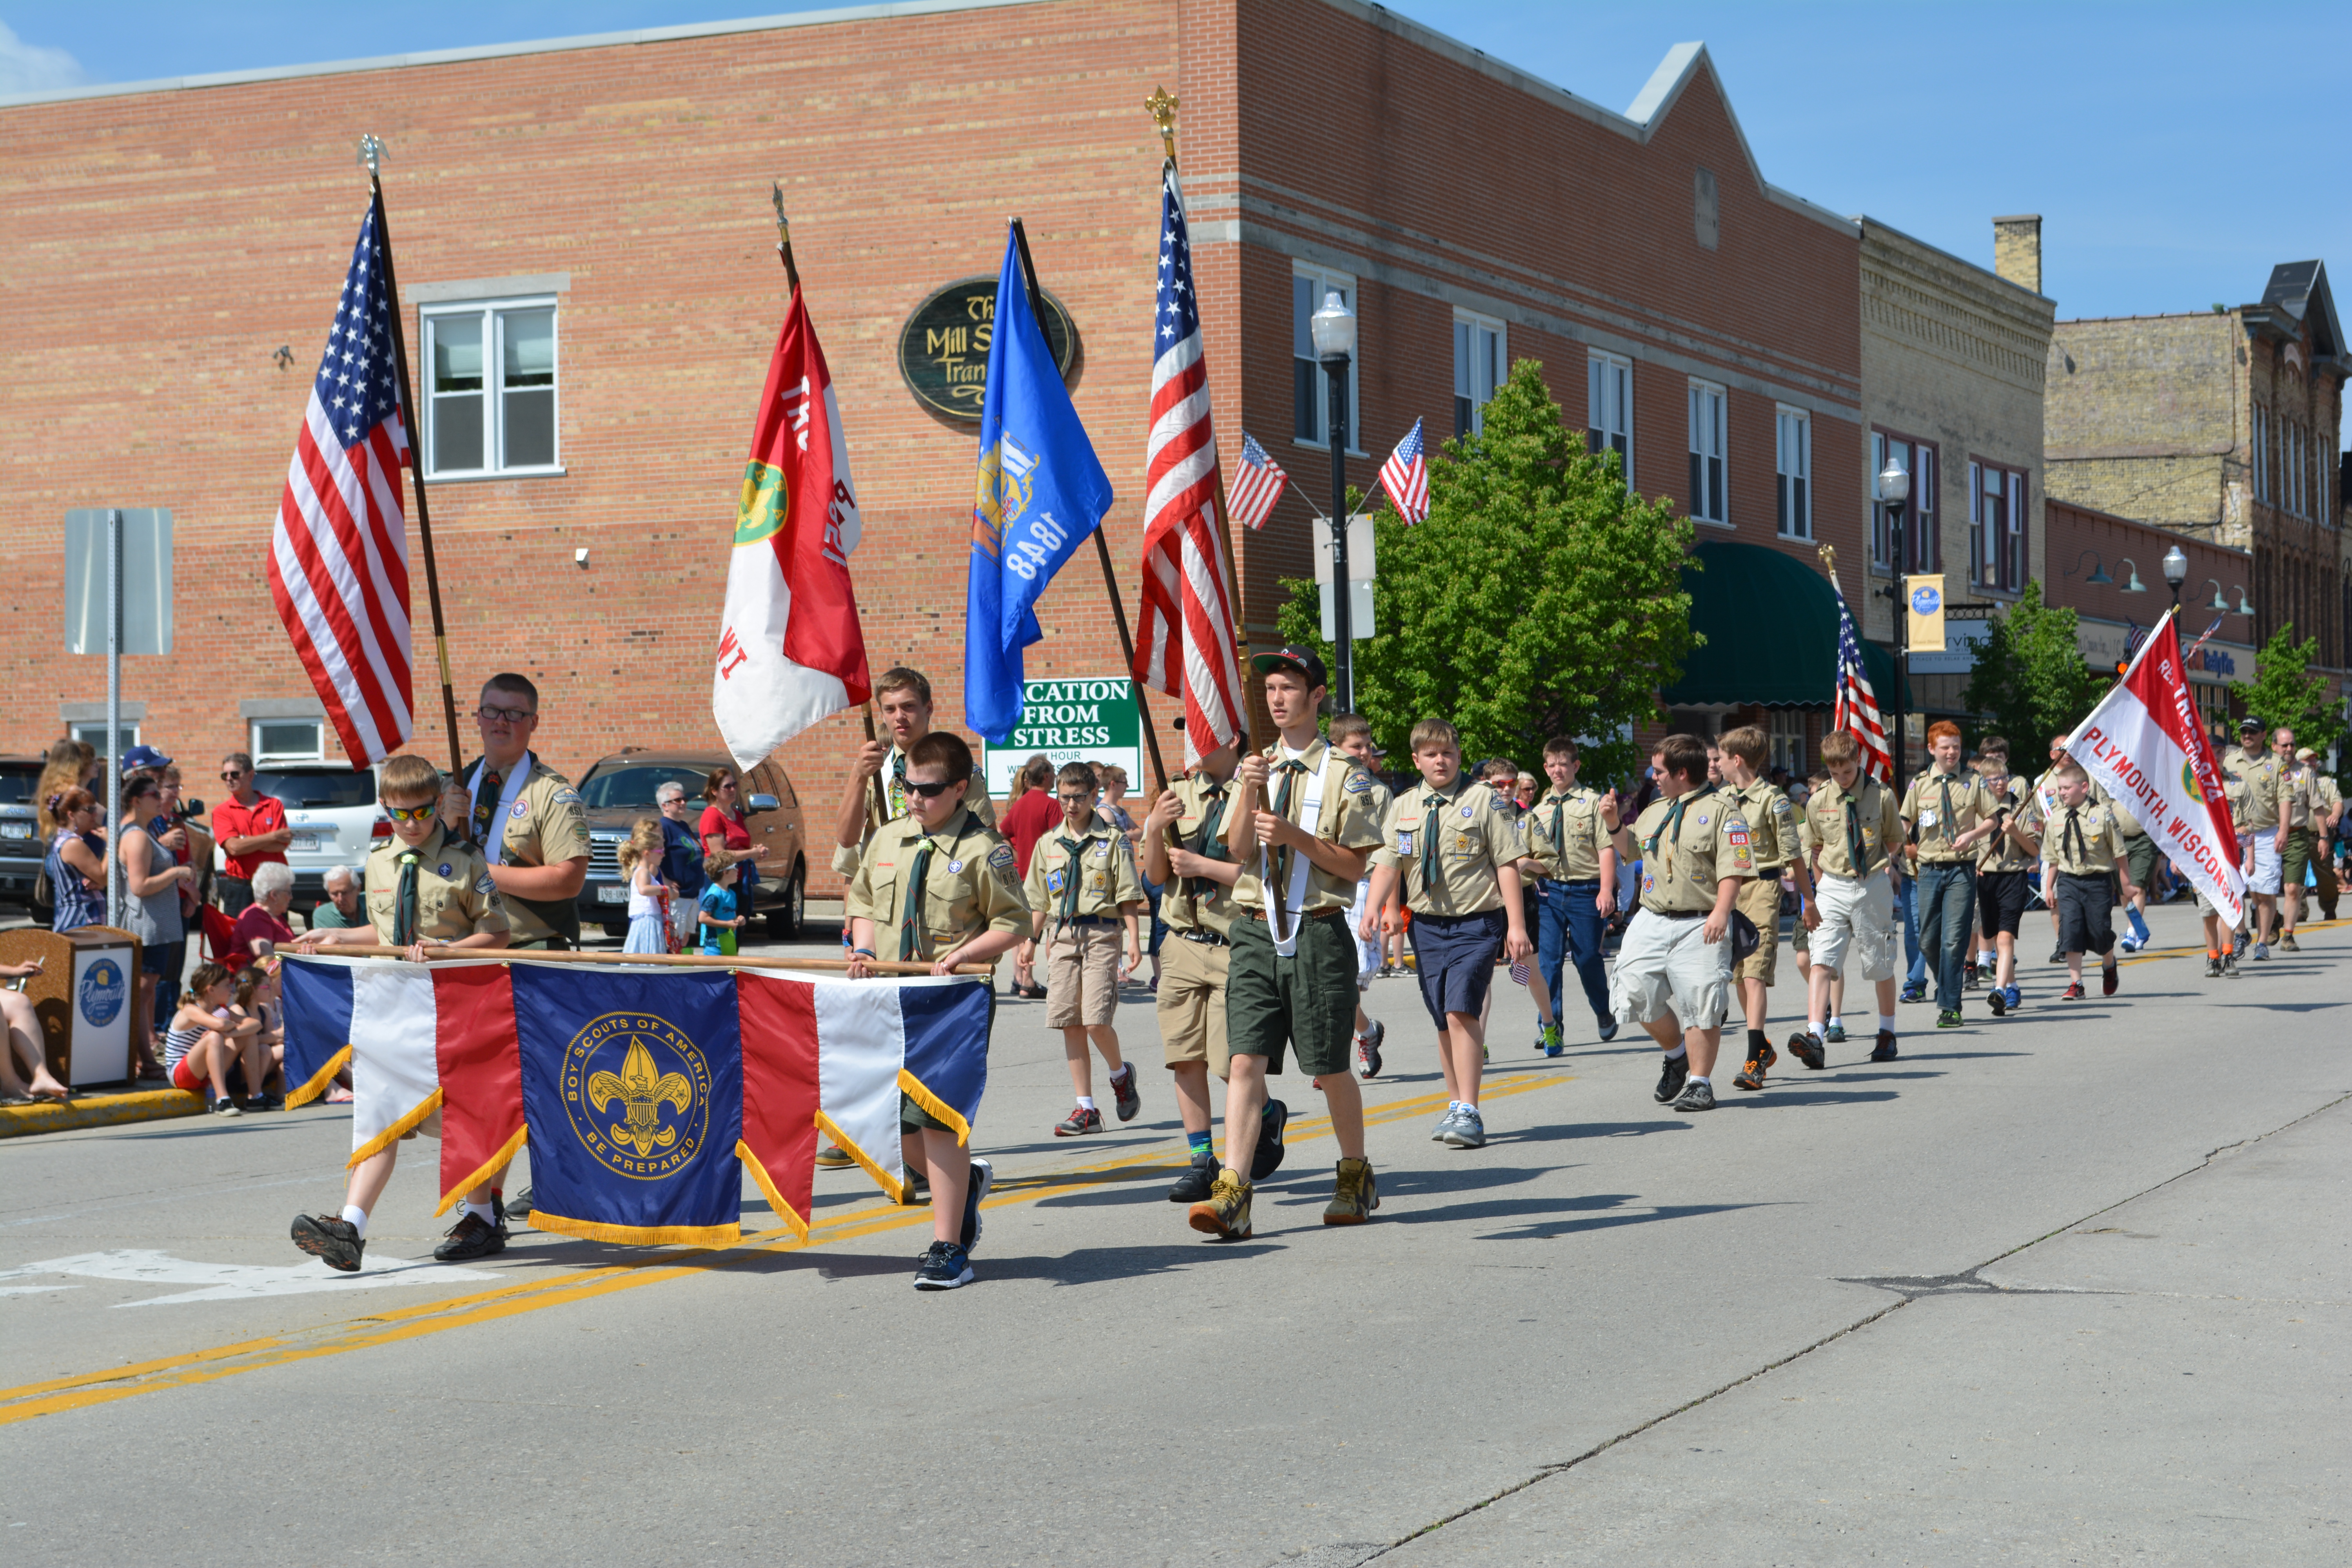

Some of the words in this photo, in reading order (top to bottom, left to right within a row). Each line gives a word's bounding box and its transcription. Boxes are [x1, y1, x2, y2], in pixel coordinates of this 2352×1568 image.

[967, 296, 994, 320] Th
[927, 327, 967, 361] Mill
[973, 324, 993, 351] S
[933, 357, 987, 383] Tran
[1911, 593, 1940, 611] Plymouth
[1023, 681, 1129, 702] CATION
[1023, 704, 1100, 724] FROM
[1014, 727, 1110, 746] STRESS
[1051, 751, 1081, 760] HOUR
[1361, 795, 1373, 806] 851
[569, 806, 583, 816] 851
[1502, 812, 1513, 821] 851
[1782, 814, 1792, 822] 851
[1732, 835, 1746, 843] 859
[2167, 816, 2241, 915] WISCONSIN
[490, 895, 501, 906] 85
[80, 980, 125, 1014] Plymouth
[568, 1063, 579, 1101] BOY
[574, 1018, 629, 1058] SCOUTS
[637, 1019, 660, 1030] OF
[666, 1032, 708, 1107] AMERICA
[587, 1131, 607, 1154] BE
[612, 1137, 695, 1172] PREPARED
